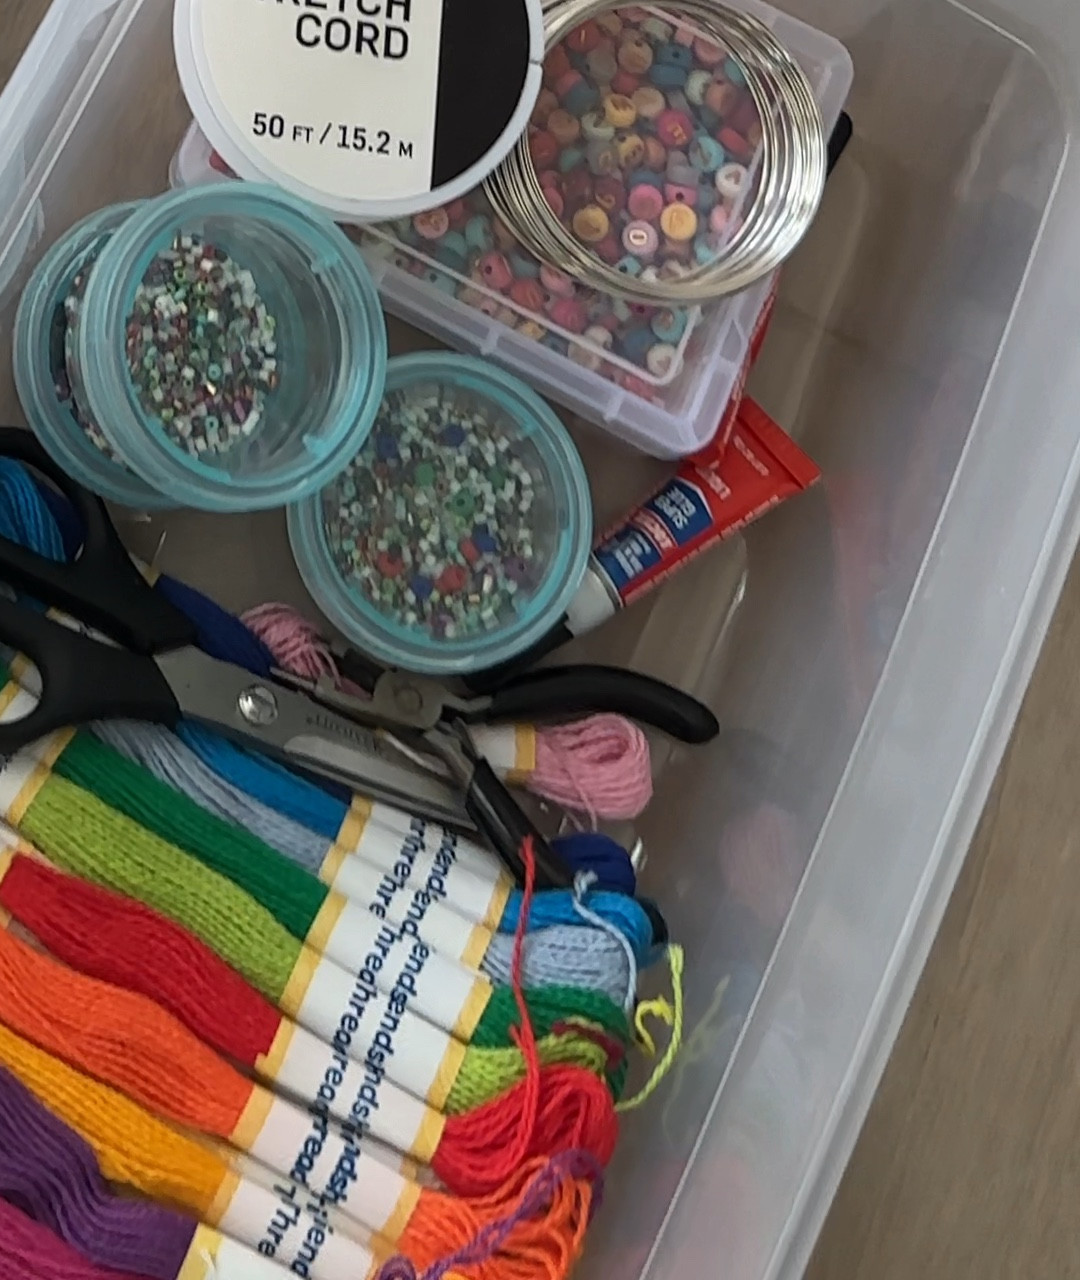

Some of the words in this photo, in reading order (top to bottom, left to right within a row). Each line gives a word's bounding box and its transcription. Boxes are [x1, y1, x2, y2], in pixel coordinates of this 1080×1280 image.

[296, 12, 409, 60] CORD
[253, 112, 284, 139] 50
[292, 125, 314, 144] FT
[337, 125, 390, 155] 15.2
[399, 140, 413, 159] M
